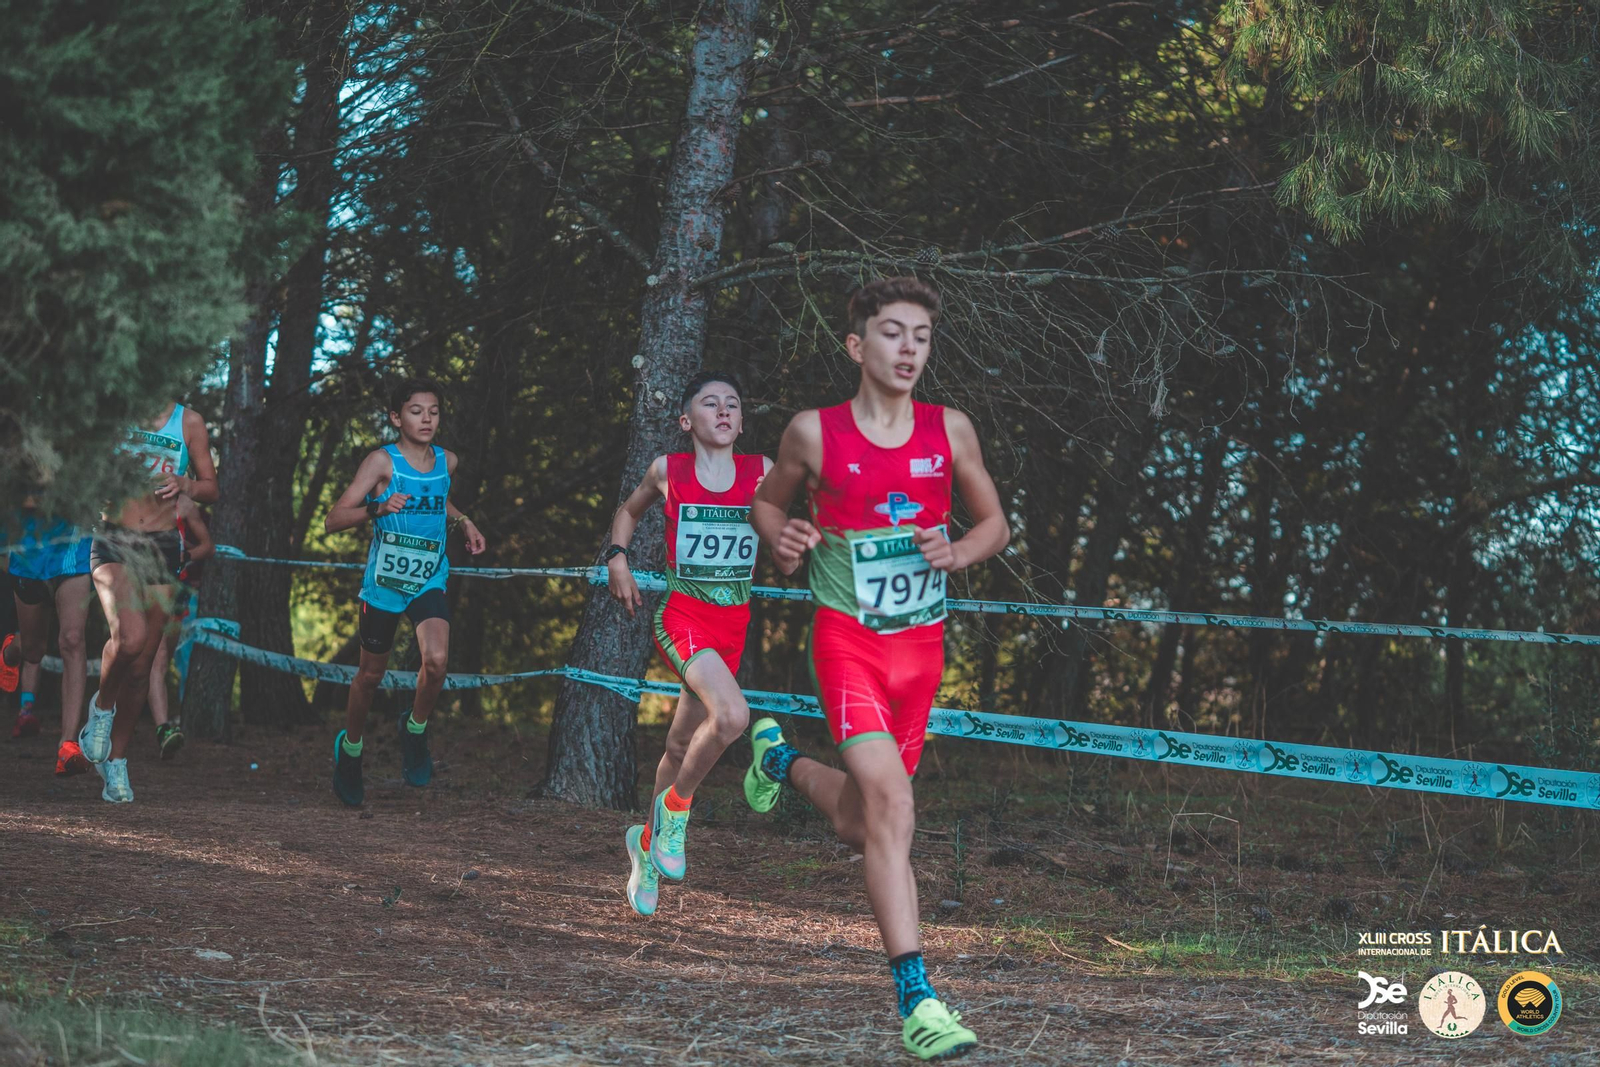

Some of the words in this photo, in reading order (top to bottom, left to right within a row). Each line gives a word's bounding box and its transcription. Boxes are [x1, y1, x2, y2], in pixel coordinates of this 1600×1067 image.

[703, 508, 741, 519] ITÁLICA
[685, 534, 753, 560] 7976
[382, 553, 435, 580] 5928
[867, 568, 942, 608] 7974
[995, 728, 1025, 741] Sevilla
[1091, 738, 1122, 752] Sevilla
[1193, 750, 1226, 764] Sevilla
[1301, 761, 1336, 776] Sevilla
[1416, 775, 1453, 789] Sevilla
[1538, 786, 1578, 802] Sevilla
